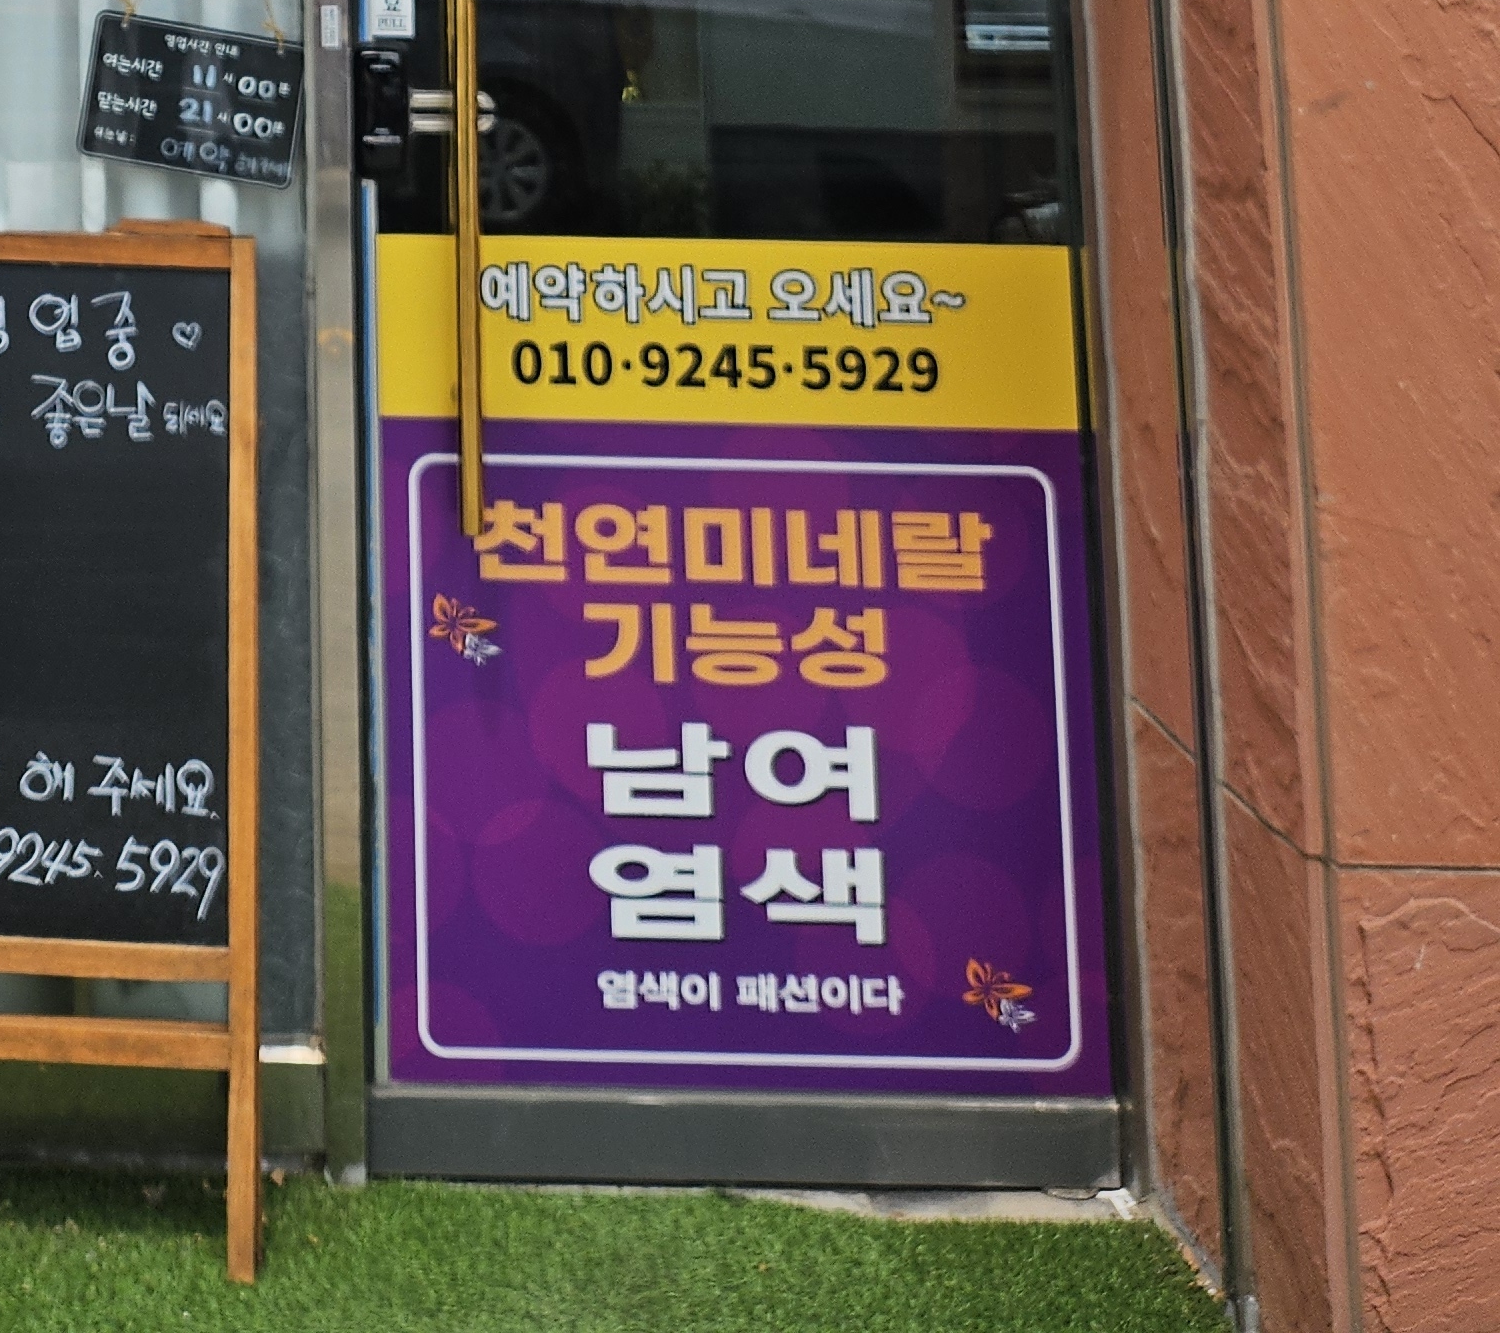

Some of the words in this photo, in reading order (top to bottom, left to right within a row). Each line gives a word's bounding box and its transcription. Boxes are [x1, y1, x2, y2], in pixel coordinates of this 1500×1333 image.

[102, 52, 164, 81] 여는시간
[480, 261, 753, 325] 예약하시고
[767, 267, 967, 329] 오세요~
[473, 500, 994, 592] 천연미네랄
[583, 603, 888, 688] 기능성
[588, 844, 886, 945] 염색
[597, 970, 722, 1012] 염색이
